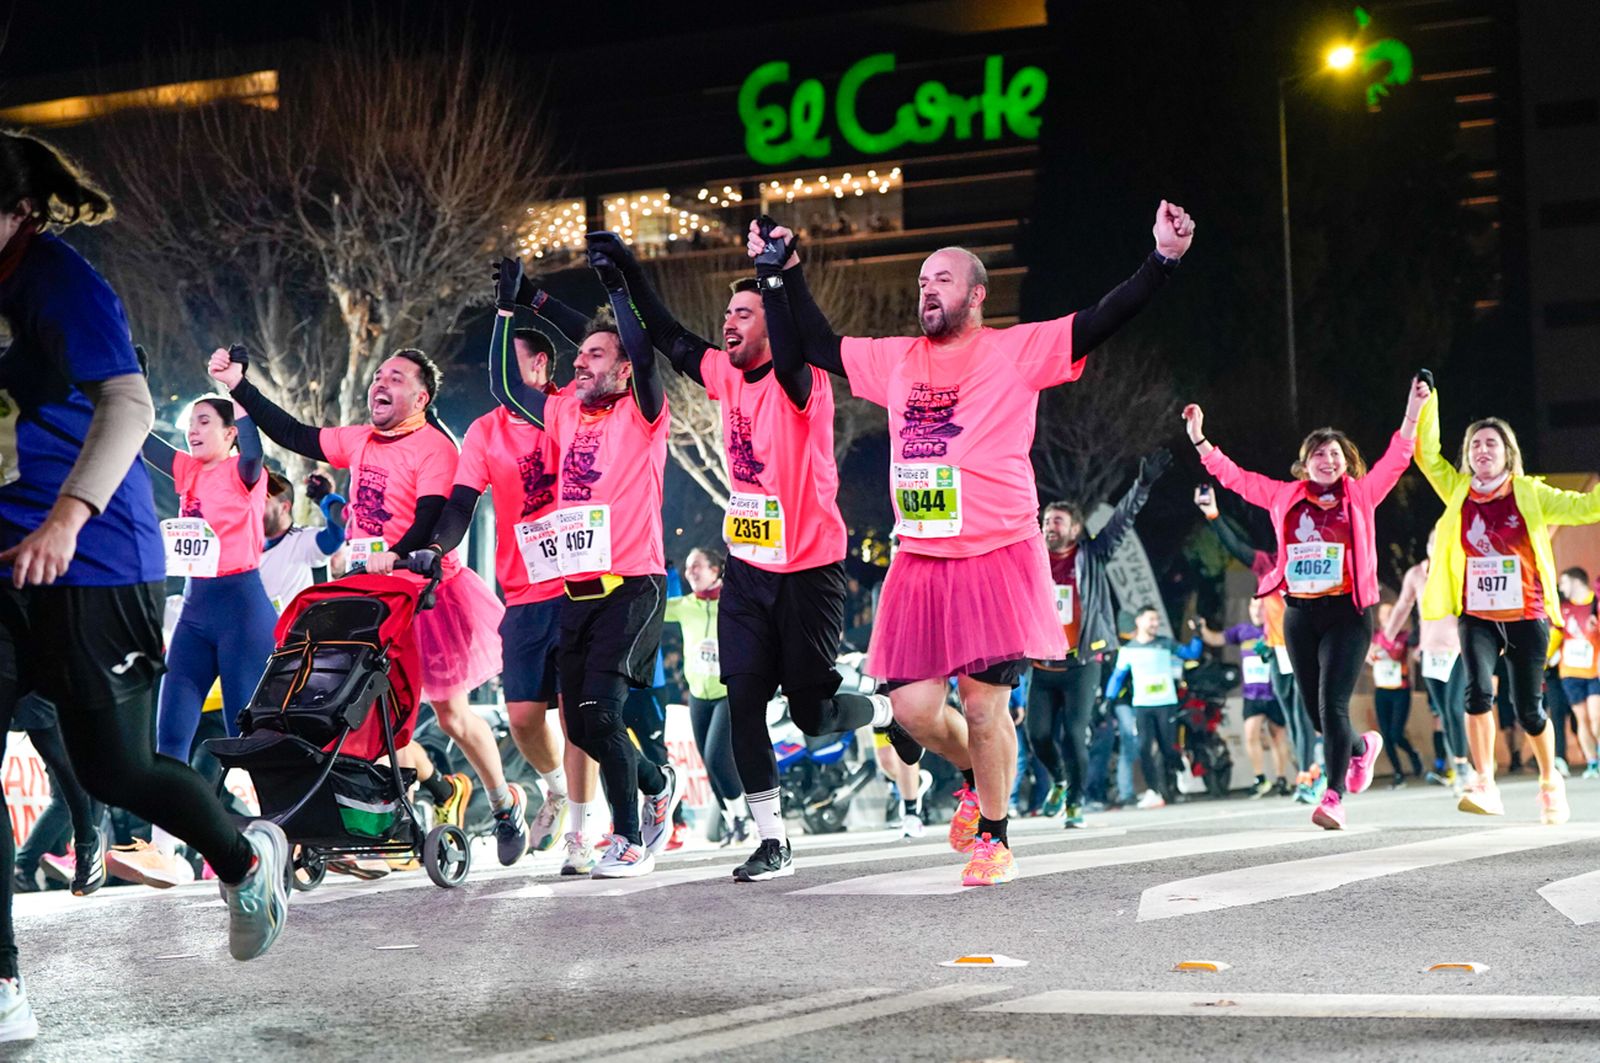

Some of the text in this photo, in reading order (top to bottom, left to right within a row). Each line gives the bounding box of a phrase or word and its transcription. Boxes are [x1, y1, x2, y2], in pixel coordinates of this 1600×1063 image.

[738, 53, 1049, 165] El Corte
[733, 517, 770, 540] 2351
[174, 538, 209, 556] 4907
[539, 534, 558, 558] 13
[565, 529, 594, 551] 4167
[1294, 559, 1332, 576] 4062
[1477, 575, 1508, 592] 4977
[4, 755, 47, 796] AN
